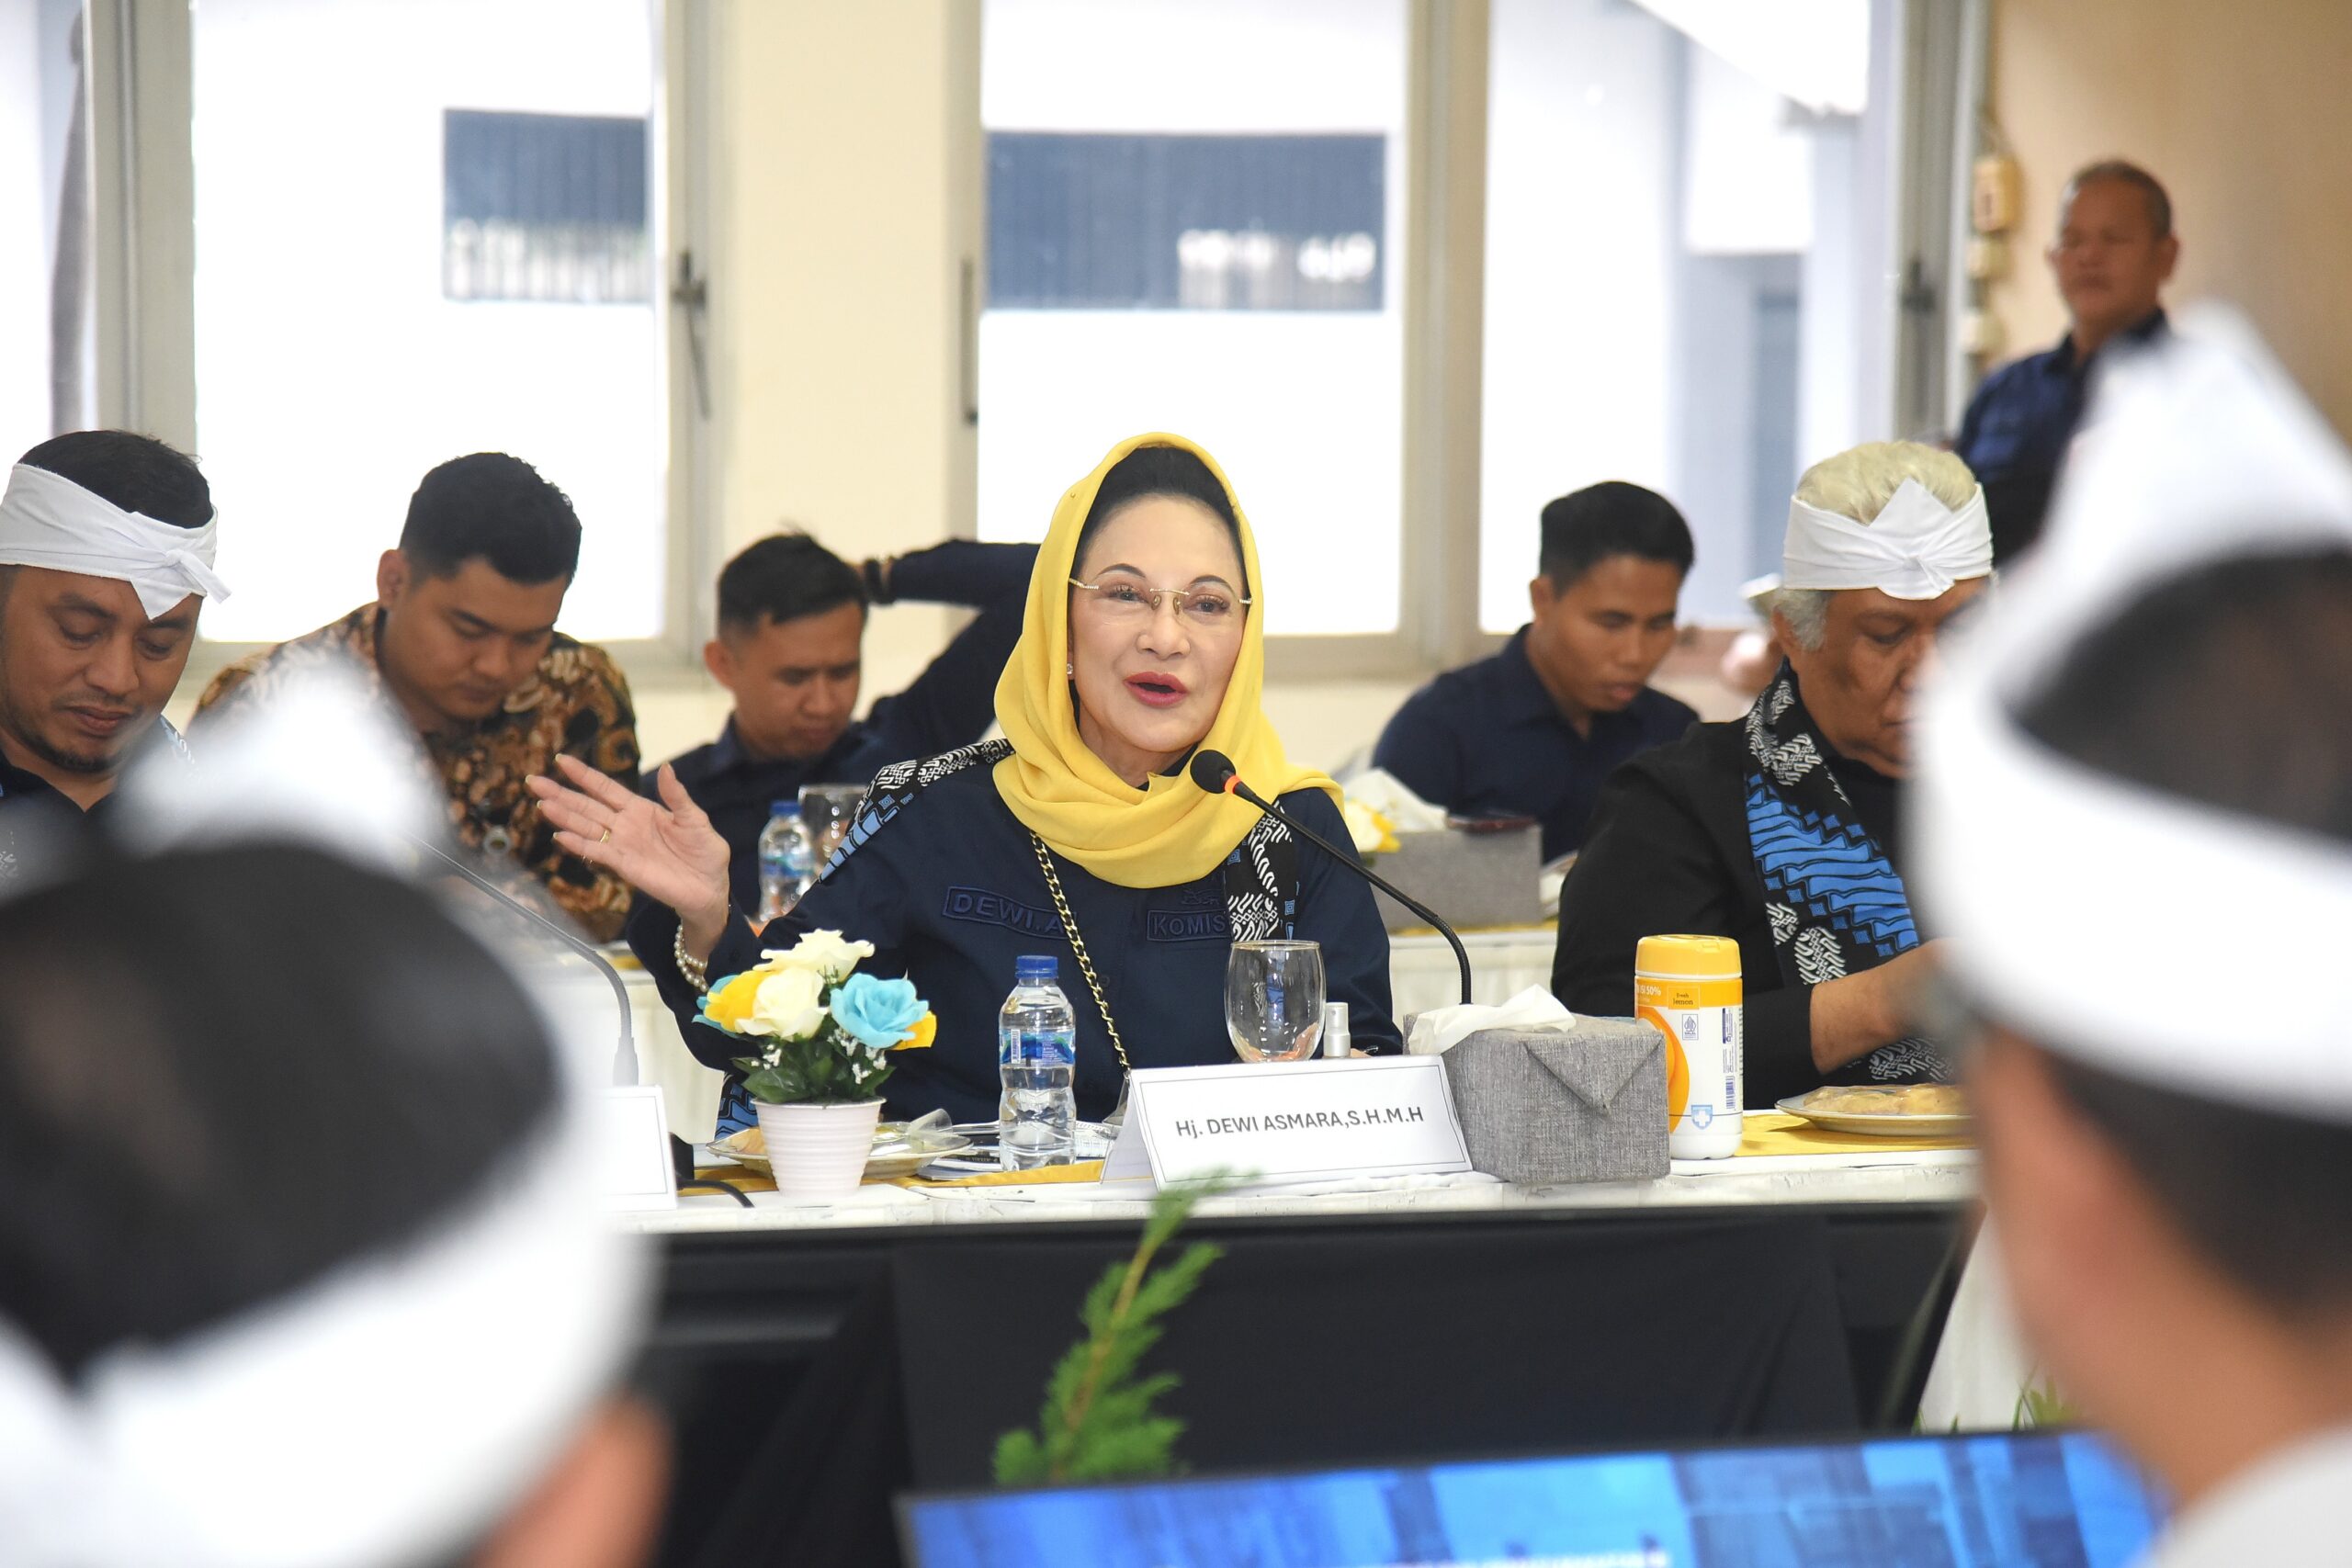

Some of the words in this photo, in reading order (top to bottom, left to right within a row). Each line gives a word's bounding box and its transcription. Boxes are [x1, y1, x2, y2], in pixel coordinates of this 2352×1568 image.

[1153, 914, 1227, 935] KOMIS
[1672, 998, 1694, 1006] lemon
[1175, 1120, 1204, 1139] Hj.
[1206, 1115, 1260, 1134] DEWI
[1263, 1106, 1424, 1132] ASMARA,S.H.M.H
